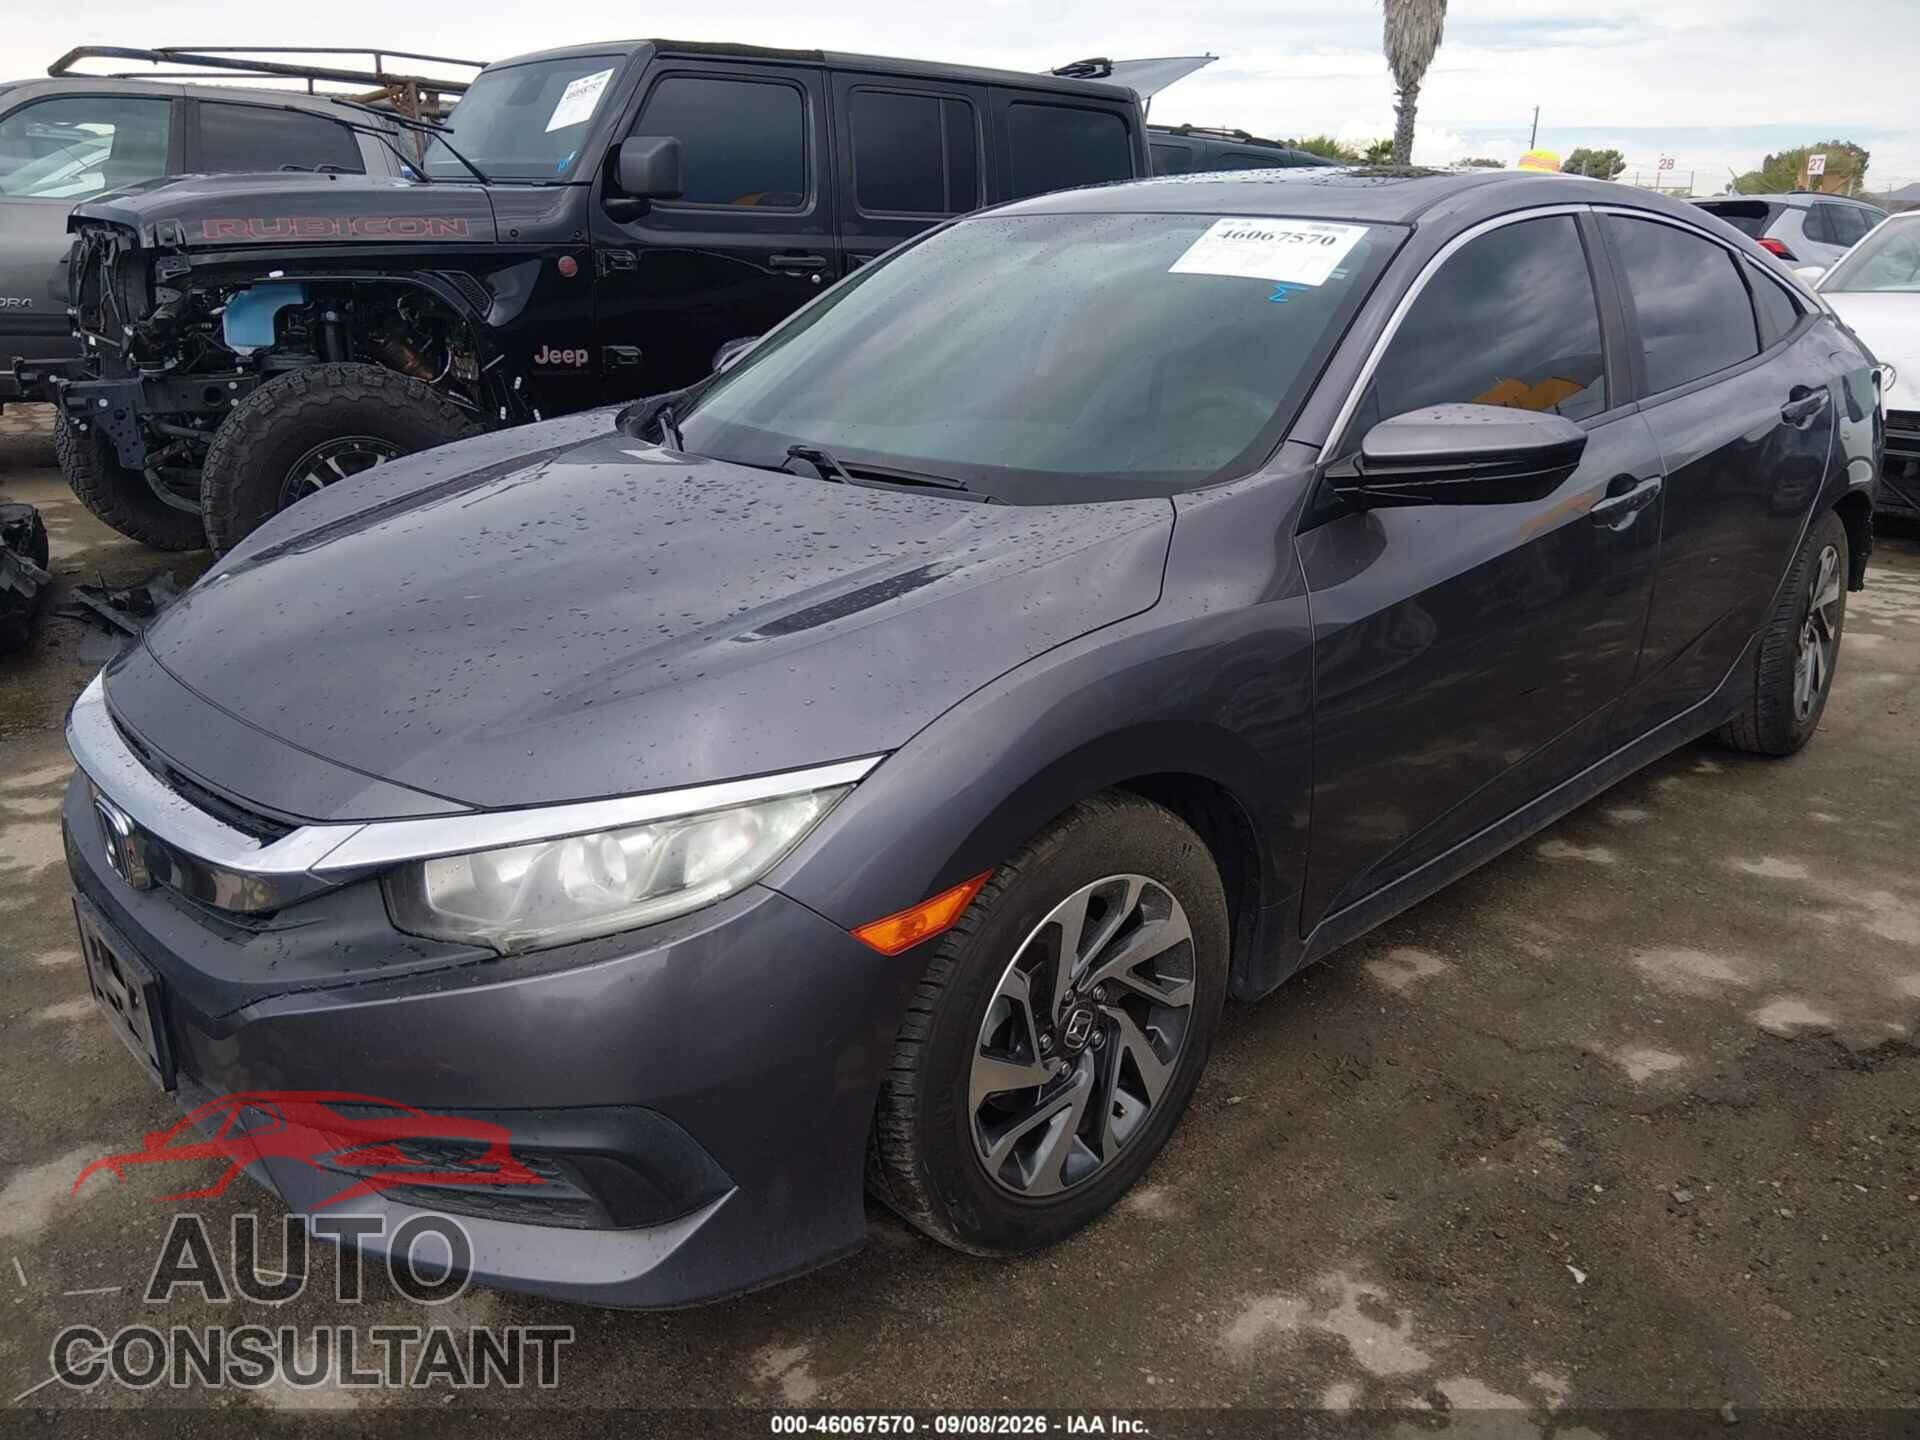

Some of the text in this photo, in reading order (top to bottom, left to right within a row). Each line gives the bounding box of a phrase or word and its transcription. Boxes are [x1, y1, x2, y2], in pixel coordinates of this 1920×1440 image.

[1657, 158, 1675, 170] 28
[1808, 158, 1825, 171] 27
[201, 217, 472, 240] RUBICON
[1216, 228, 1337, 247] 46067570
[533, 344, 589, 368] Jeep
